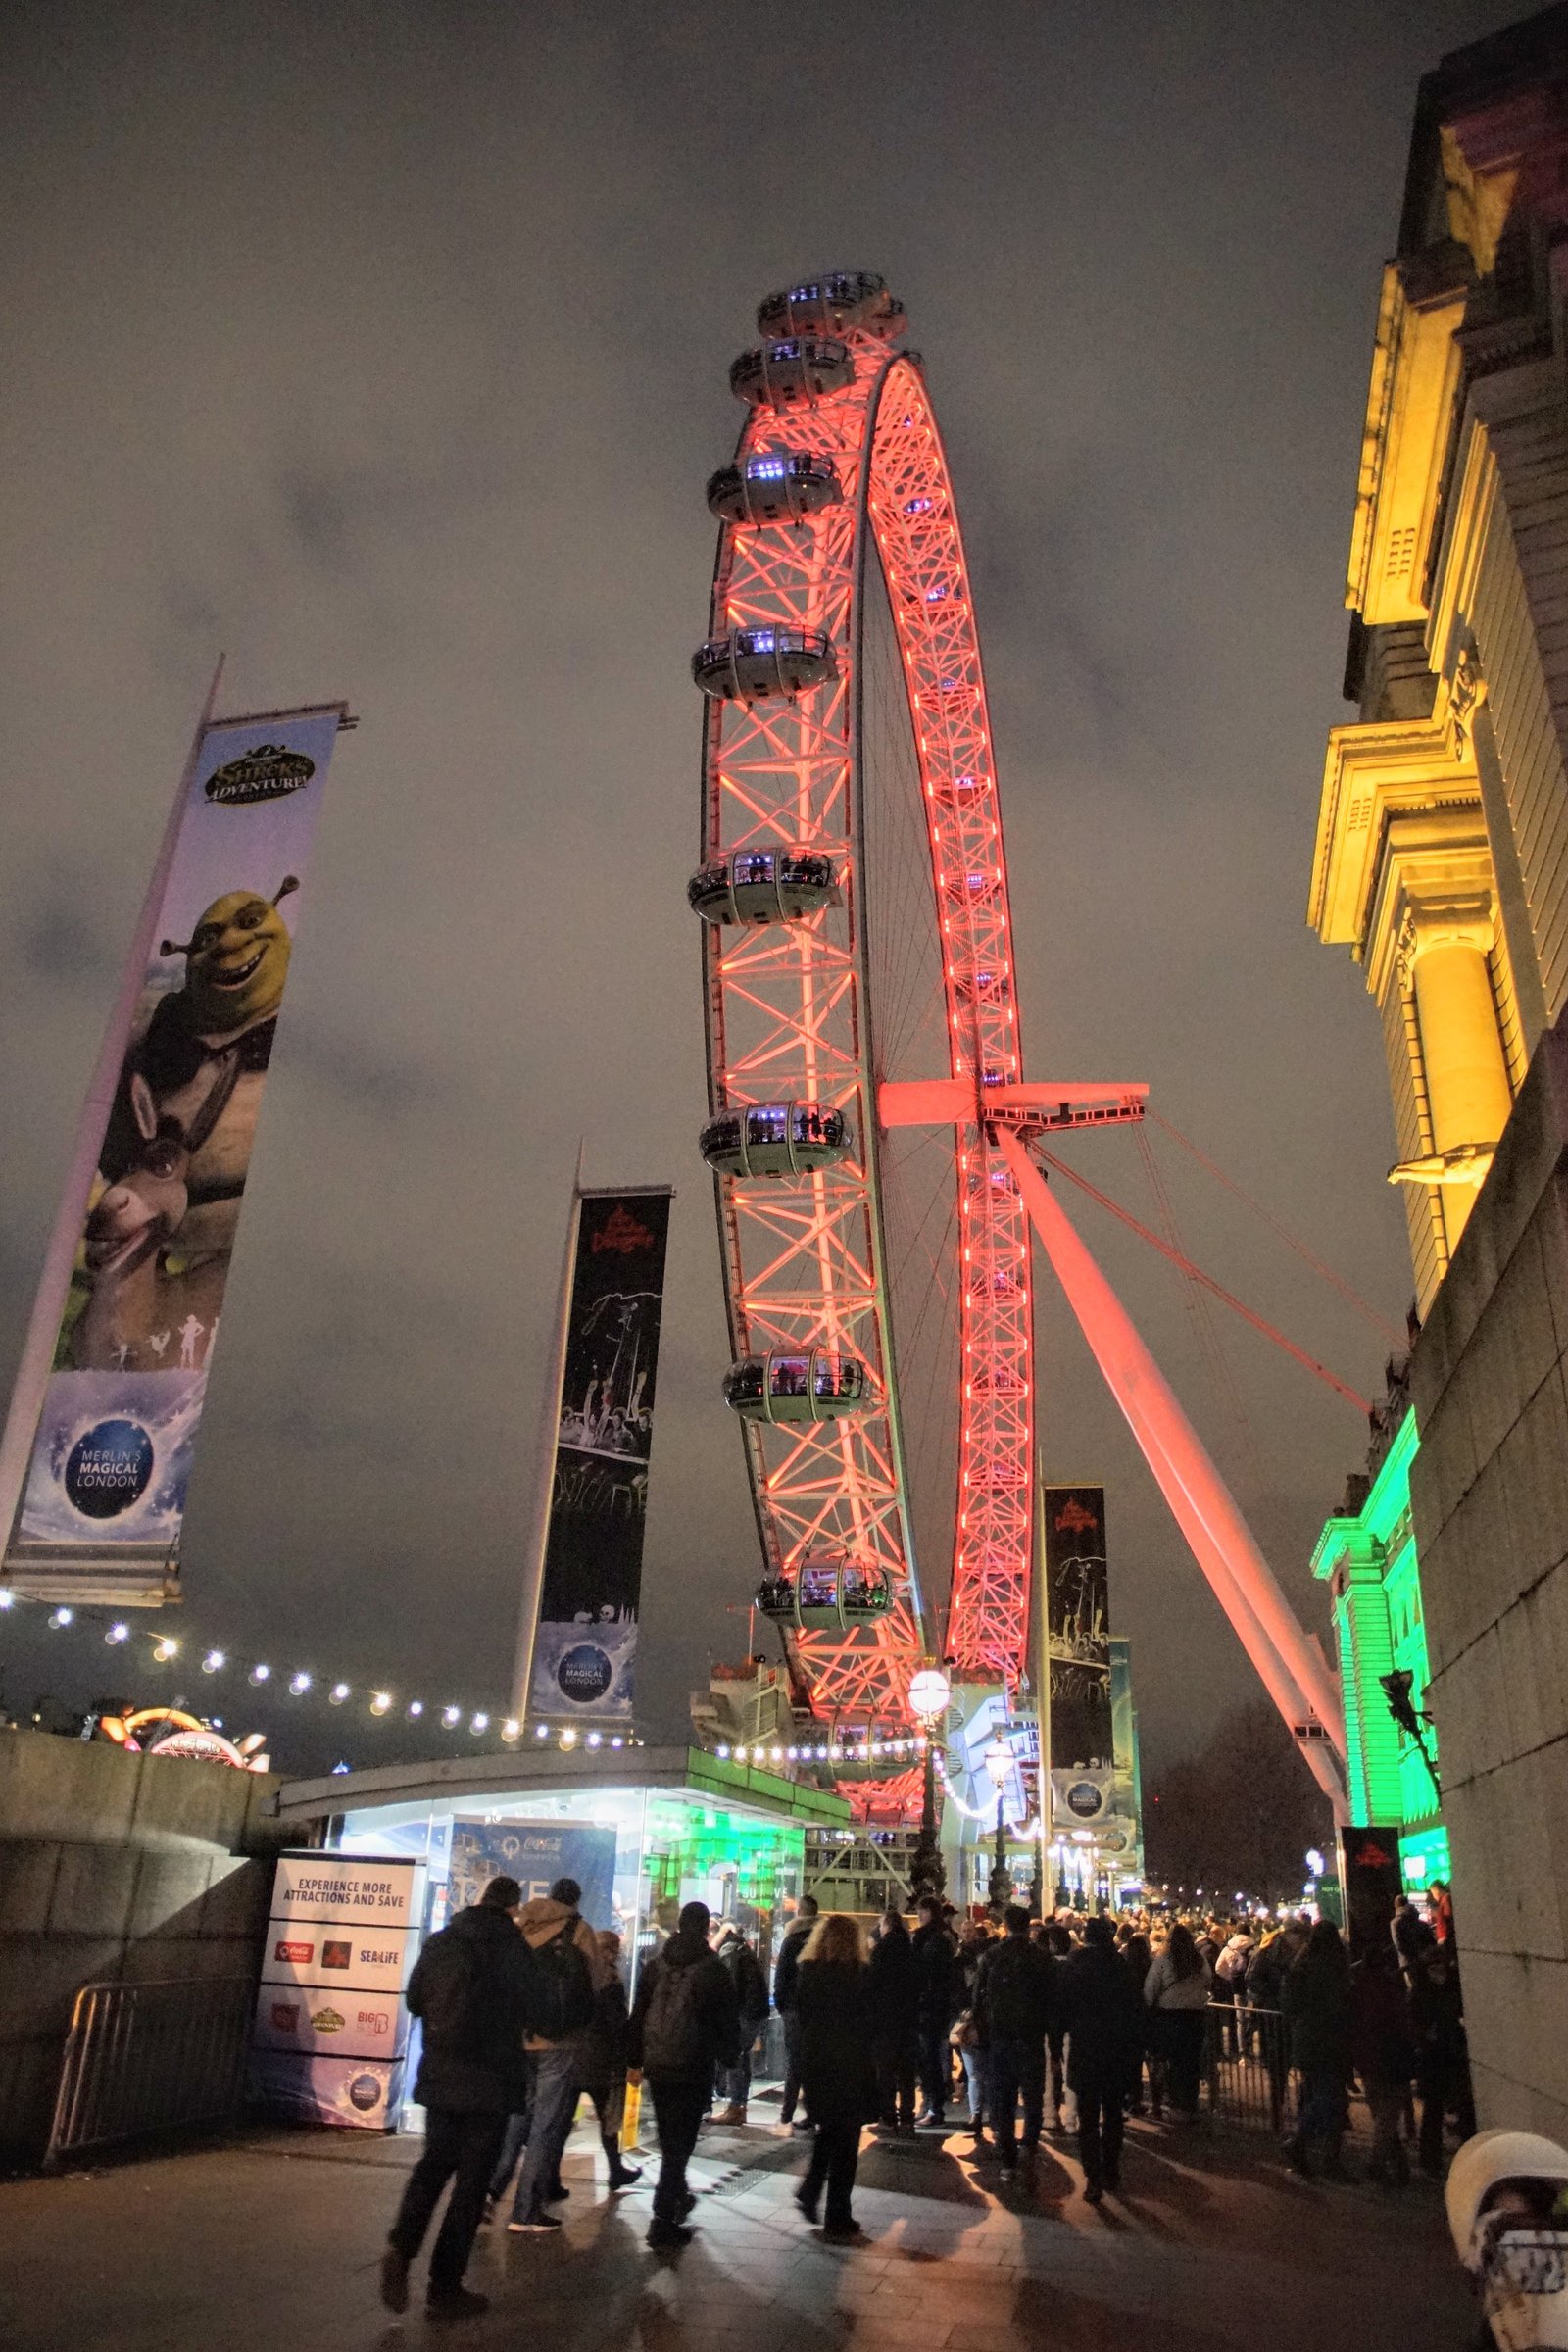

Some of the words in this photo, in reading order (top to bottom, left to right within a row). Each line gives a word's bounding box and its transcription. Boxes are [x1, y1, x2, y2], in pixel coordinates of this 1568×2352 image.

[82, 1450, 142, 1462] MERLIN'S
[79, 1462, 138, 1474] MAGICAL
[77, 1475, 137, 1488] LONDON
[565, 1677, 604, 1686] LONDON
[298, 1879, 360, 1892] EXPERIENCE
[362, 1883, 393, 1894] MORE
[283, 1889, 352, 1905] ATTRACTIONS
[353, 1894, 375, 1906] AND
[378, 1895, 405, 1908] SAVE
[360, 1950, 378, 1963] SEA
[358, 2011, 375, 2023] BIG
